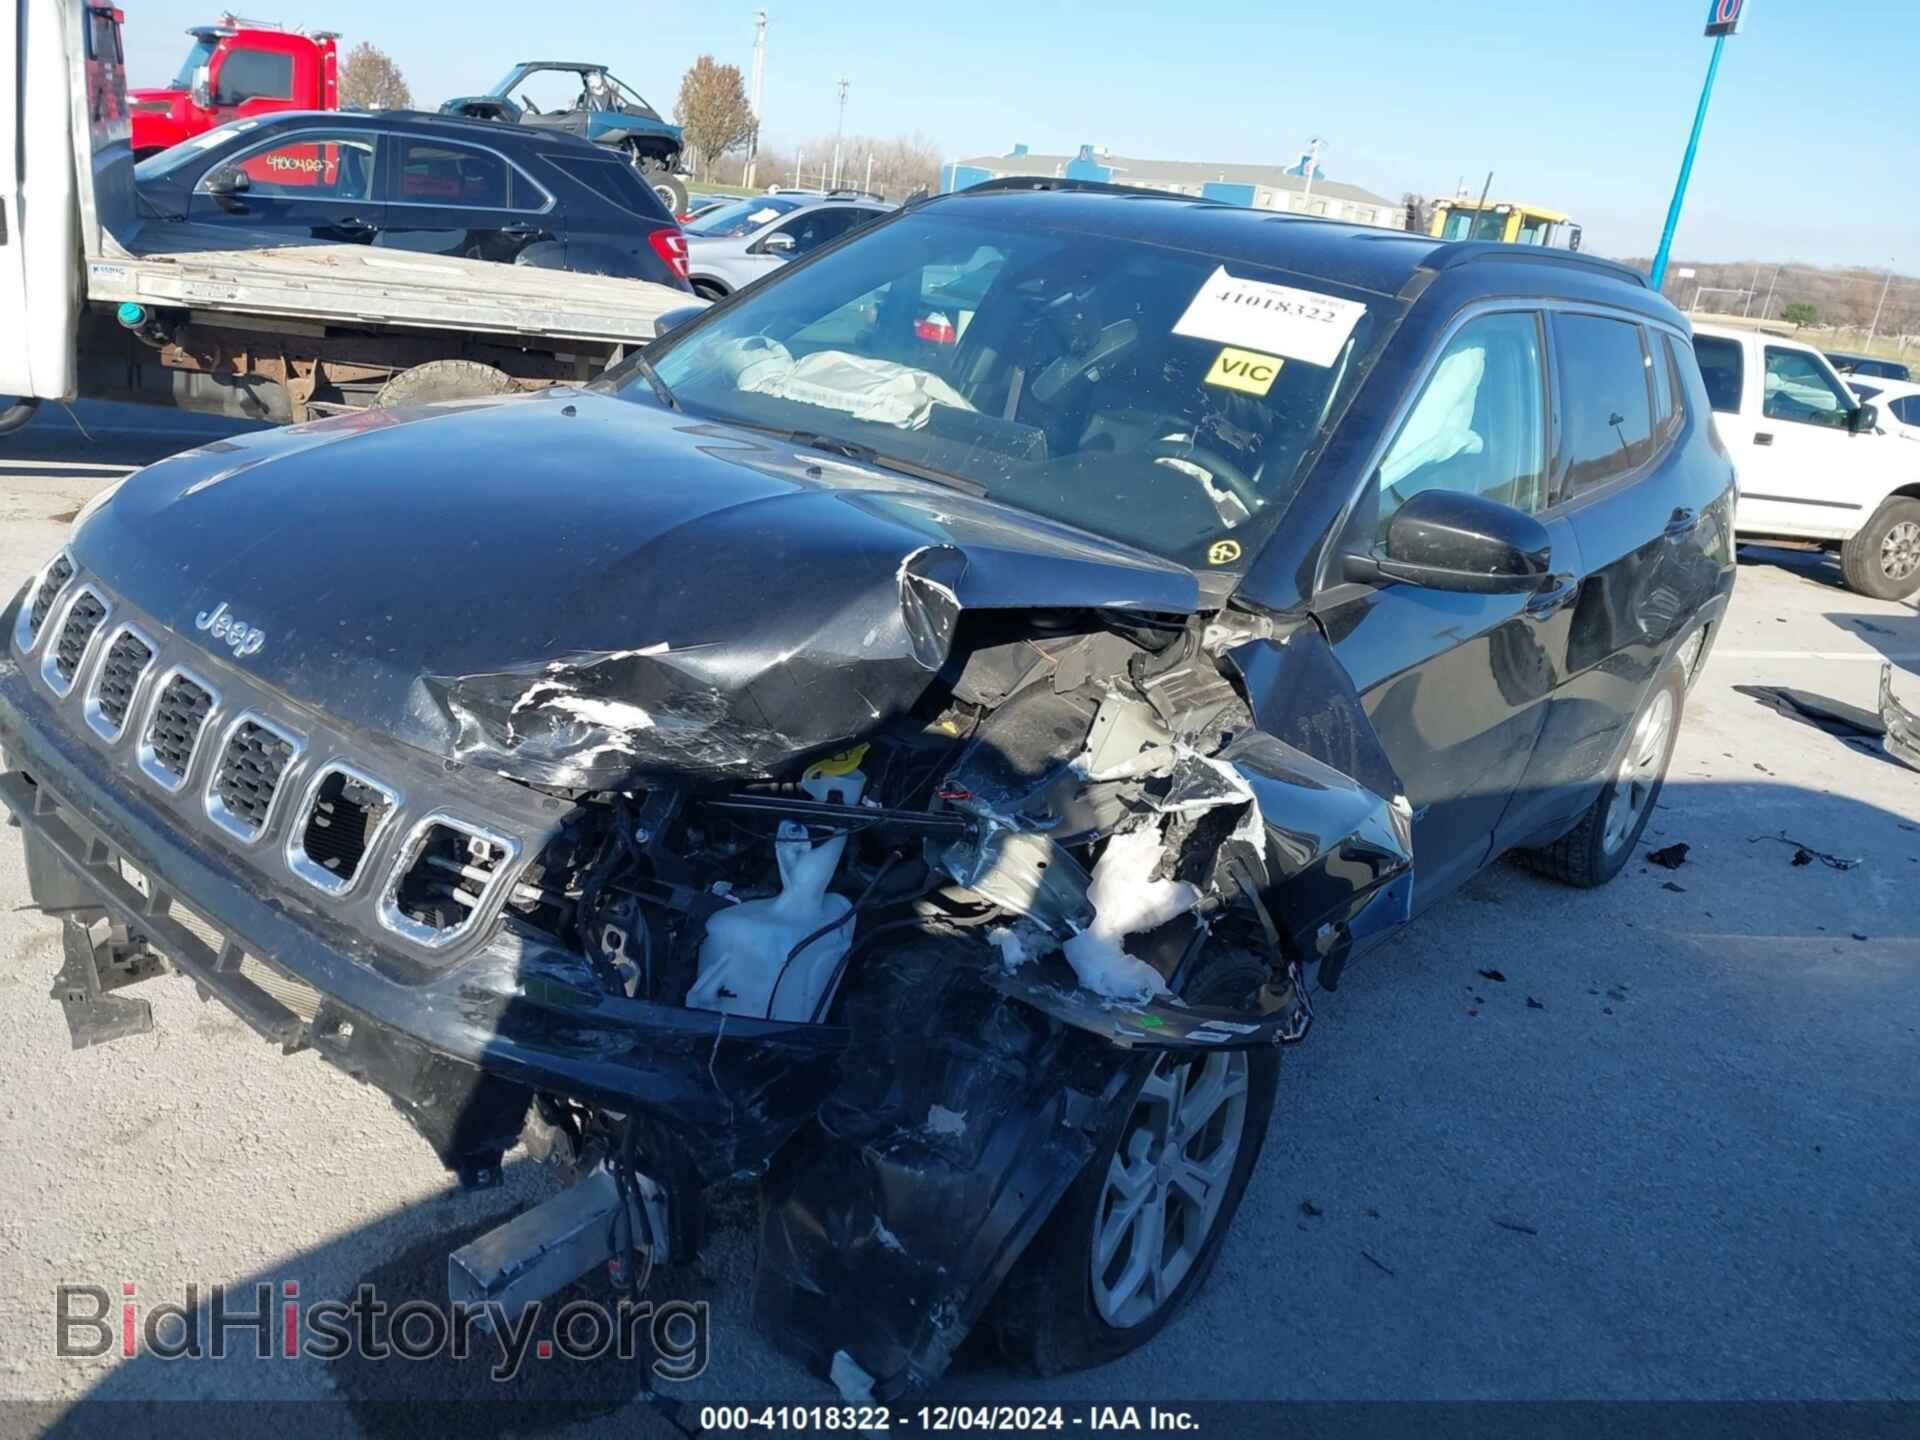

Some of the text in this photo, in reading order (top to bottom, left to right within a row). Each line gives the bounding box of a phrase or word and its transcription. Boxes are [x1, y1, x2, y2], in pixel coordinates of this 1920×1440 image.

[1217, 291, 1336, 323] 41018322
[1222, 357, 1273, 382] VIC
[195, 601, 266, 657] Jeep
